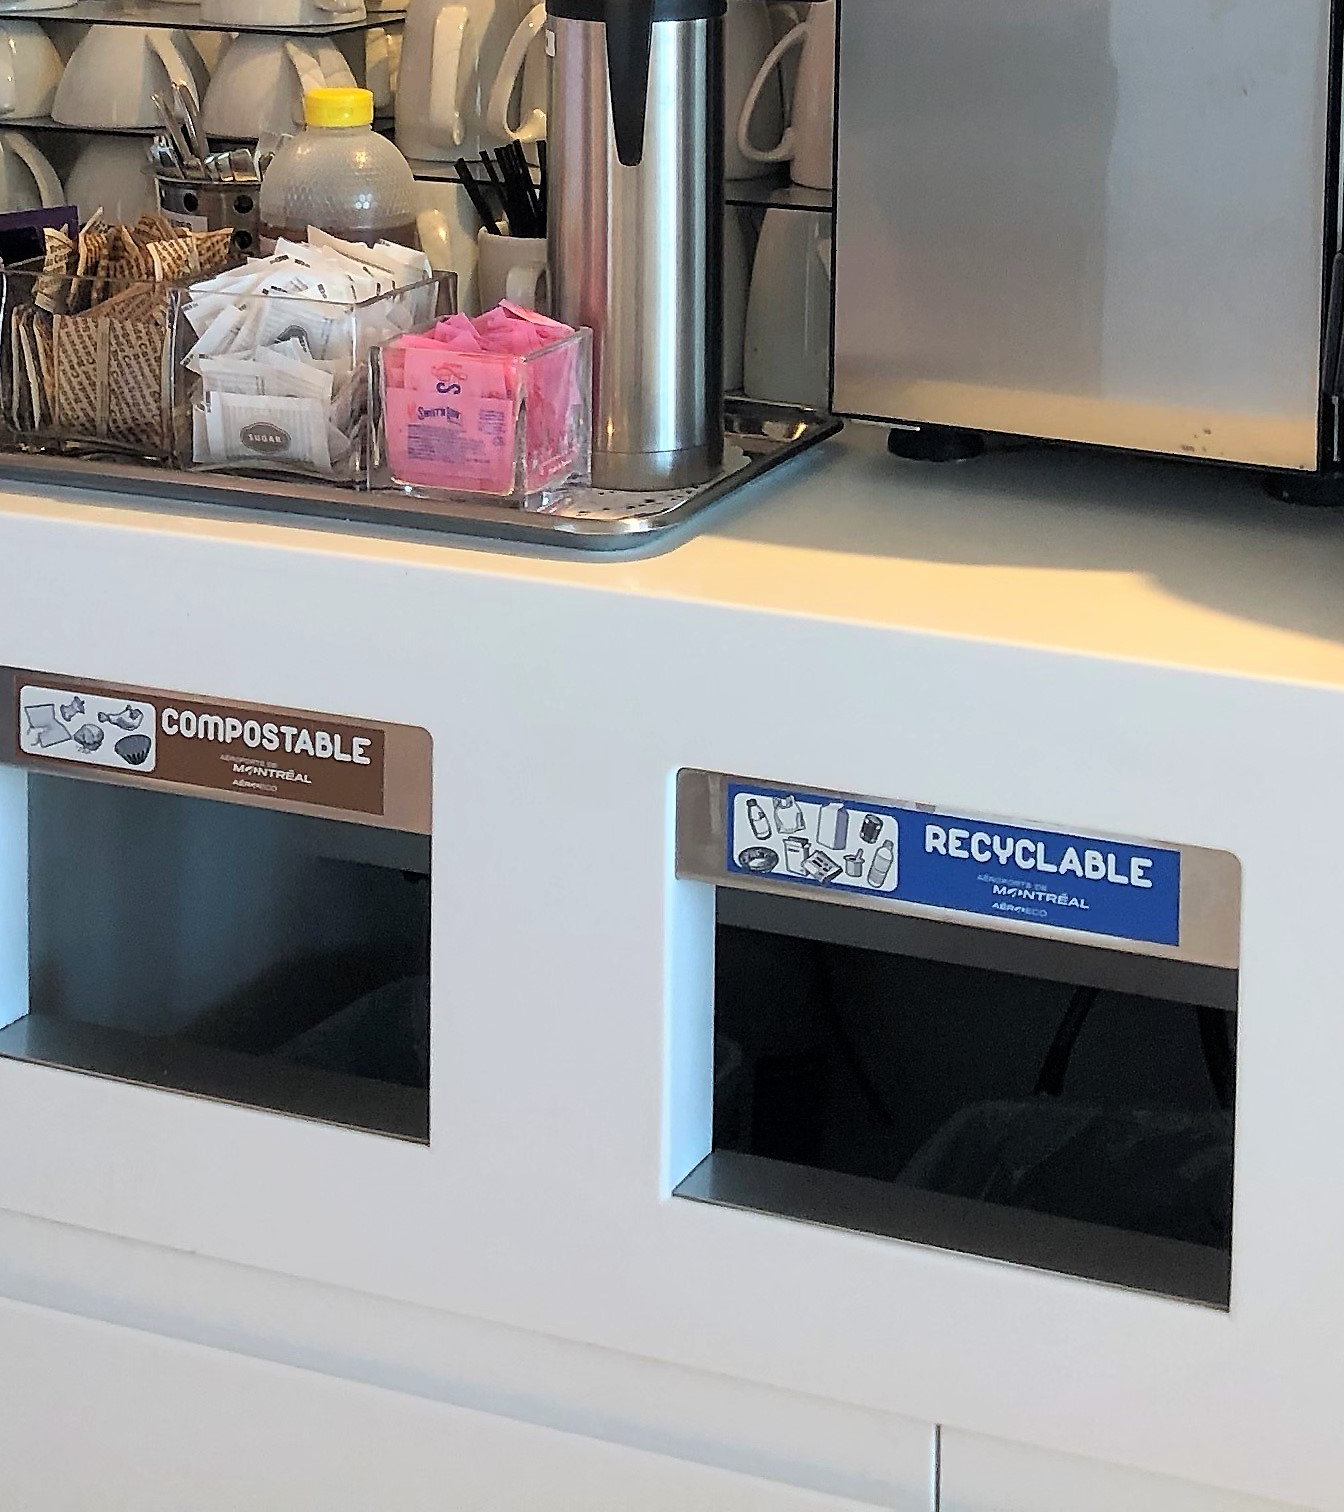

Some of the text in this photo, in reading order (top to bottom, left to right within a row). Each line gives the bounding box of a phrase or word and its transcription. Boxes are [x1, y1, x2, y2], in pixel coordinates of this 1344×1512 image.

[247, 432, 282, 444] SUGAR
[161, 707, 371, 765] COMPOSTABLE
[924, 824, 1154, 888] RECYCLABLE
